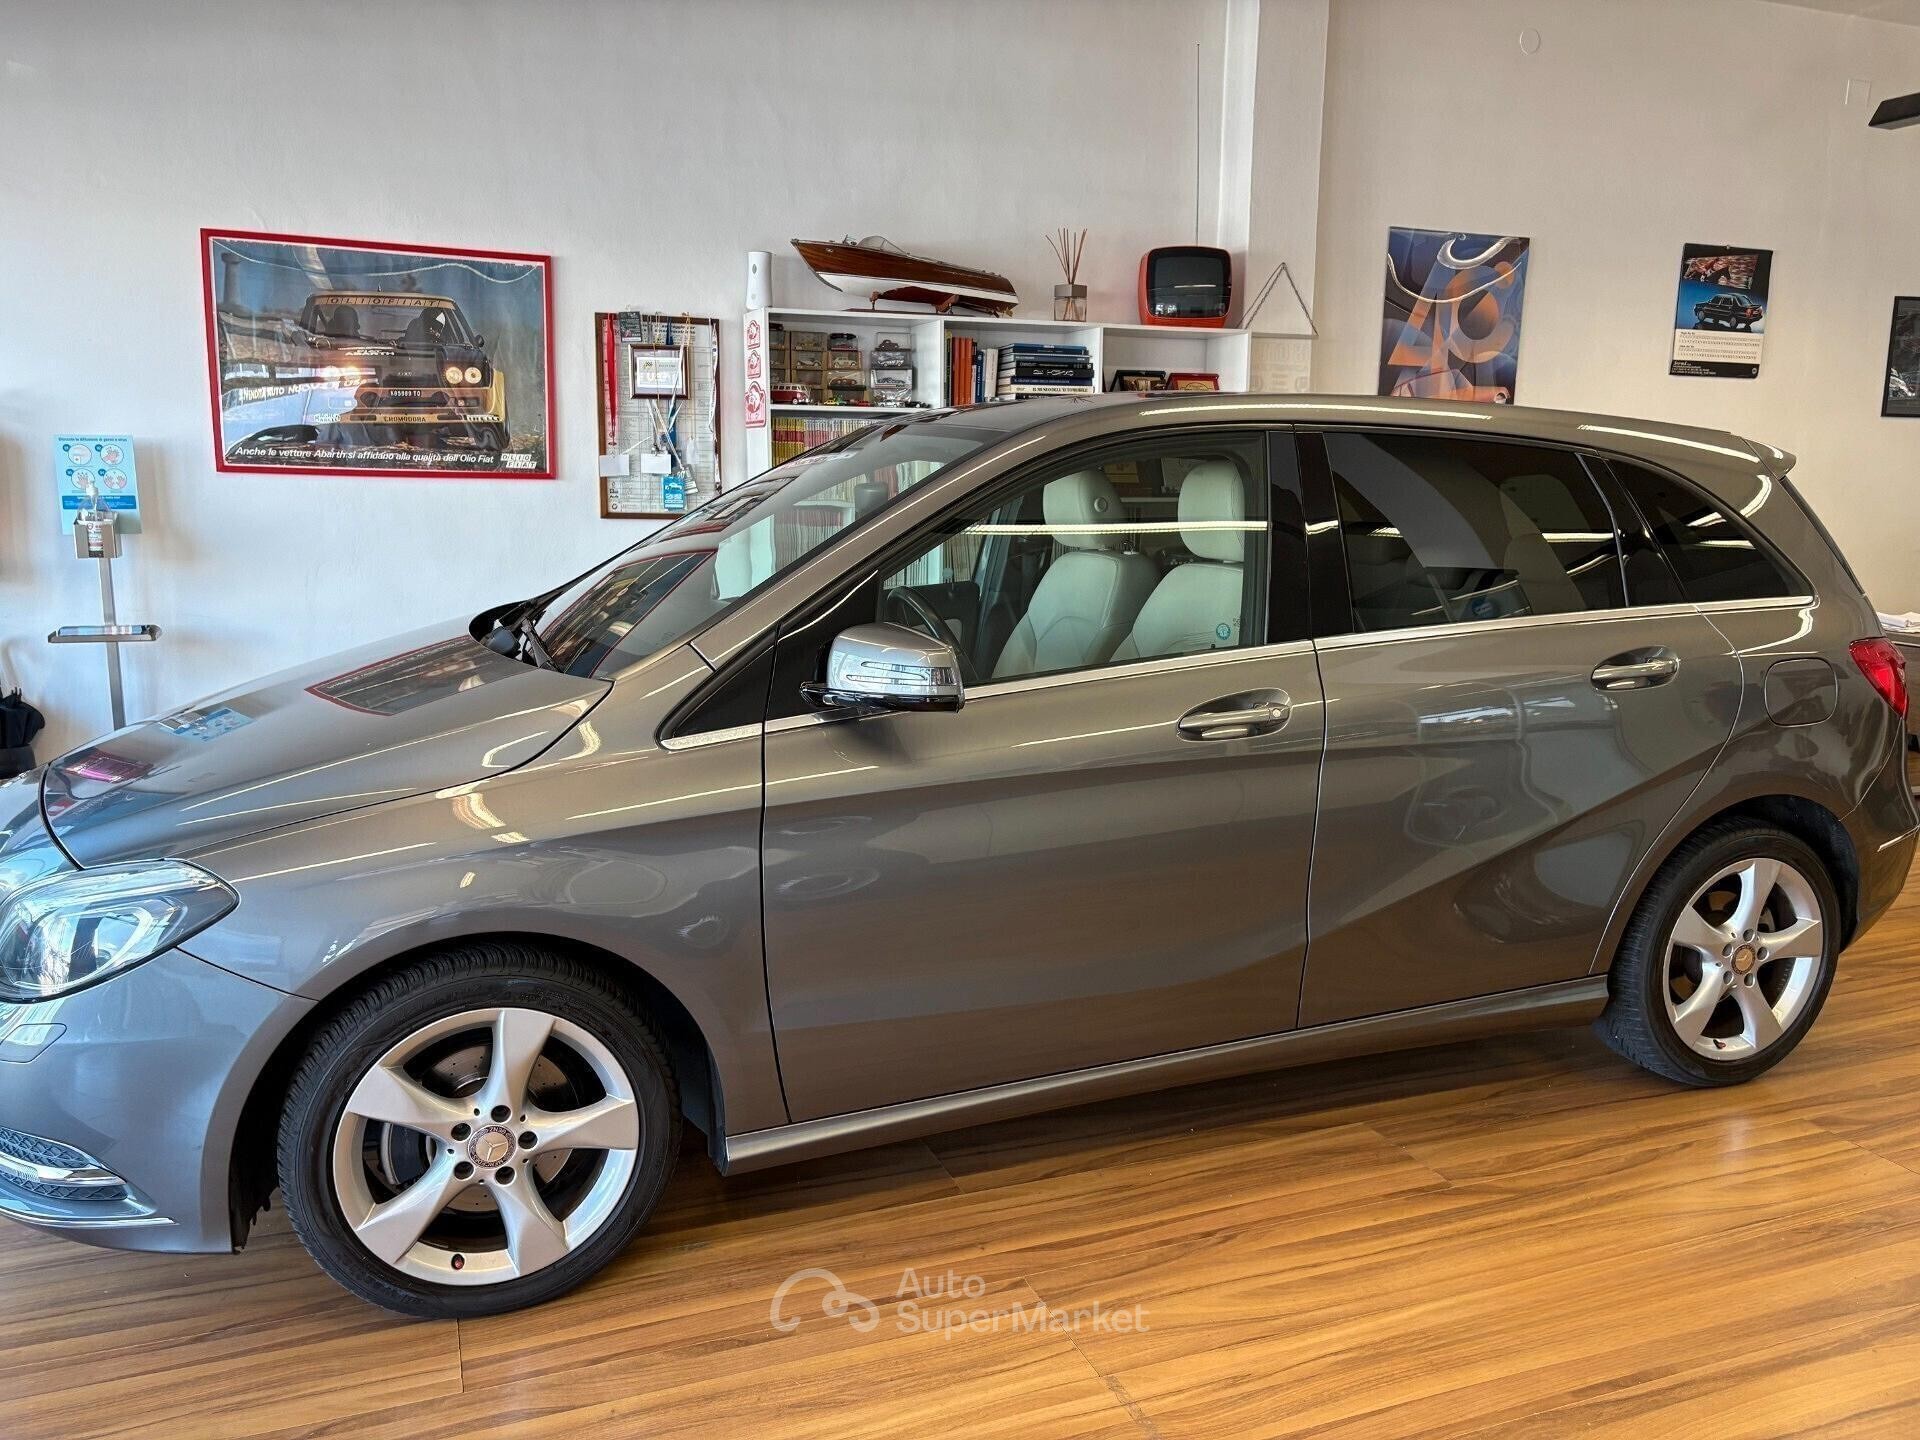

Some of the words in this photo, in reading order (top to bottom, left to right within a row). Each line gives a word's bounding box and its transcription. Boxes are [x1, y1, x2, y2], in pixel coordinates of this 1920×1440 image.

[234, 447, 266, 456] Anche
[268, 448, 277, 456] le
[278, 449, 312, 458] vetture
[314, 449, 346, 459] Abarth
[348, 452, 356, 460] si
[357, 452, 393, 460] affidano
[395, 453, 411, 461] alla
[412, 452, 441, 464] qualità
[443, 453, 477, 462] dell'Olio
[478, 454, 494, 464] Fiat
[501, 453, 532, 462] OLIO
[505, 461, 537, 469] FIAT
